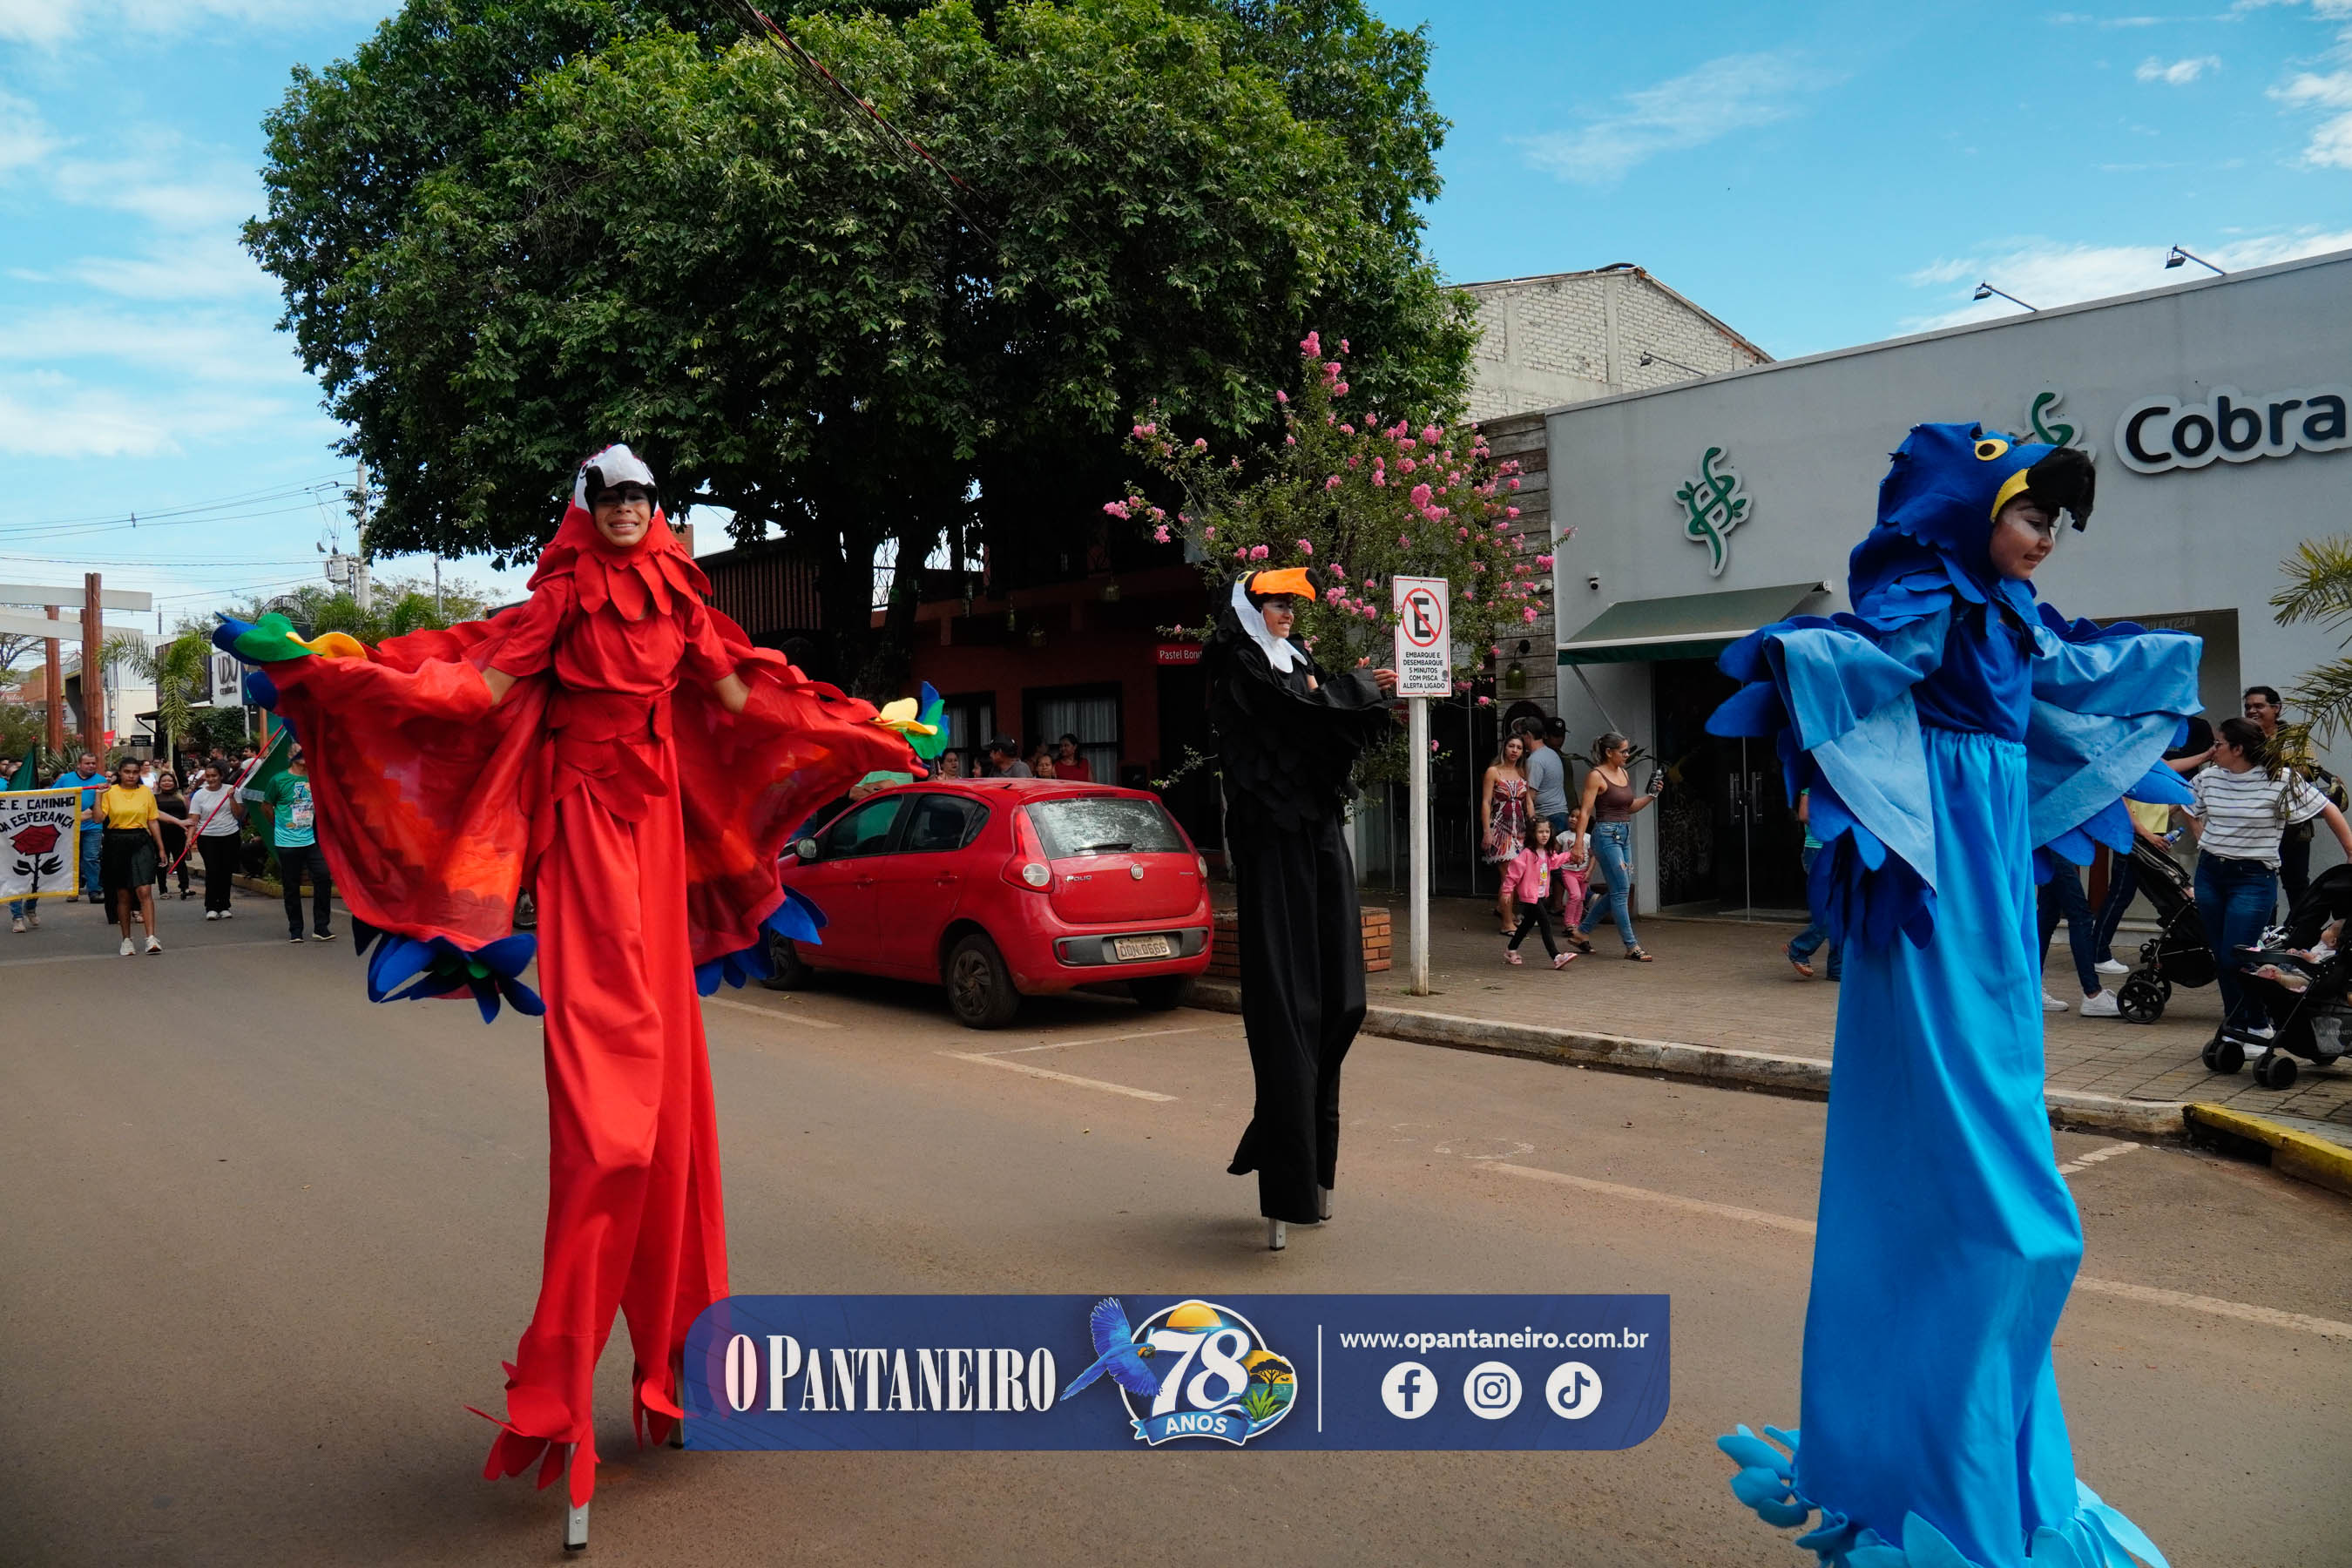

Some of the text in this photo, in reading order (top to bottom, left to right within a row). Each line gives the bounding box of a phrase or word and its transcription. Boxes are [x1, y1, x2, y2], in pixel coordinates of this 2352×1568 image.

[2126, 395, 2347, 463] Cobra
[1159, 650, 1182, 659] Pastel
[27, 796, 76, 810] CAMINHO
[10, 811, 76, 829] ESPERANÇA
